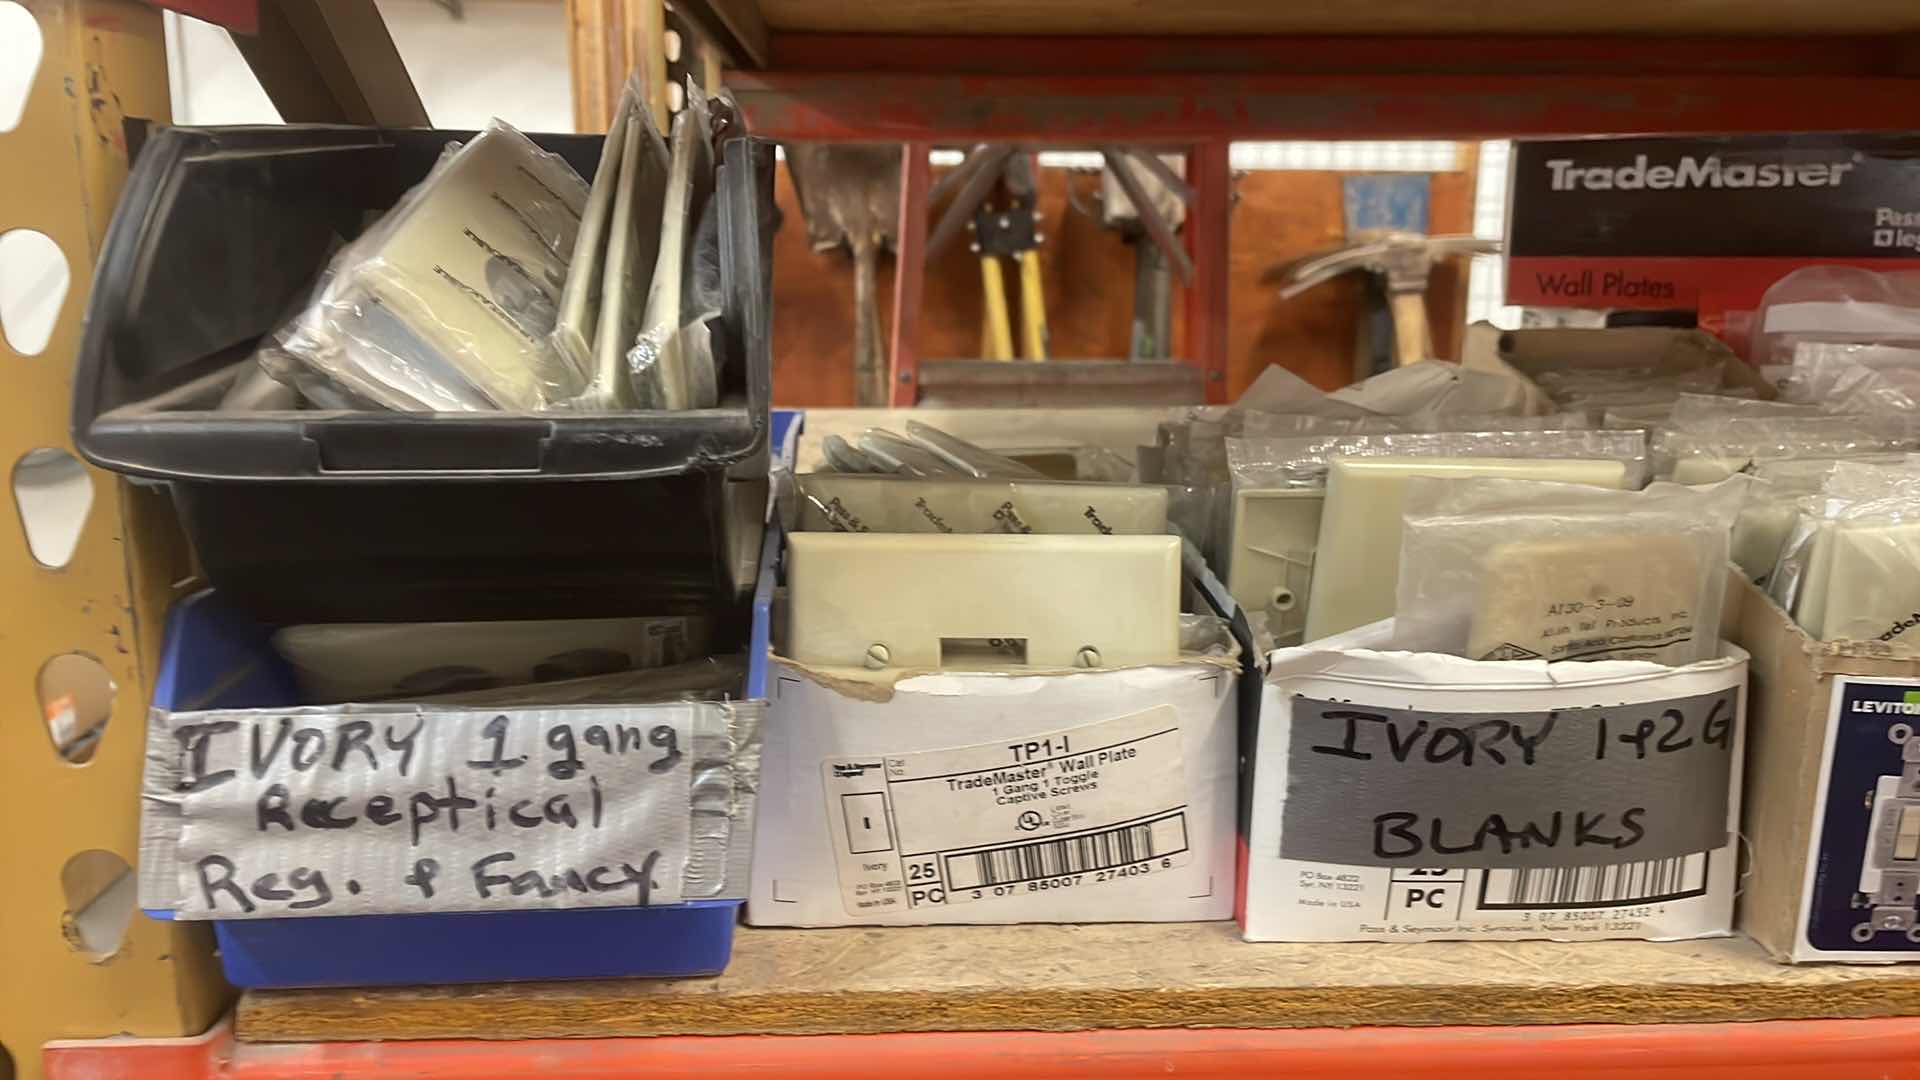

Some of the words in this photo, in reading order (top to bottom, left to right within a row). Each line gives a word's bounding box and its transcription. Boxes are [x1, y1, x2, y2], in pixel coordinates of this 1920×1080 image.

[1536, 271, 1592, 298] Wall
[1603, 271, 1676, 298] Plates
[1312, 710, 1558, 766] IVORY
[173, 714, 424, 793] IVORY
[1059, 755, 1095, 774] Wall
[1098, 748, 1137, 766] Plate
[996, 790, 1048, 806] Captive
[1050, 781, 1098, 798] Screws
[1003, 782, 1039, 796] Gang
[1053, 770, 1099, 788] Toggle
[1372, 808, 1646, 859] BLANKS
[909, 862, 936, 880] 25
[971, 890, 983, 900] 3
[993, 885, 1016, 897] 07
[1027, 875, 1083, 892] 85007
[1096, 863, 1151, 883] 27403
[1161, 858, 1172, 870] 6
[911, 887, 945, 907] PC
[1405, 888, 1446, 909] PC
